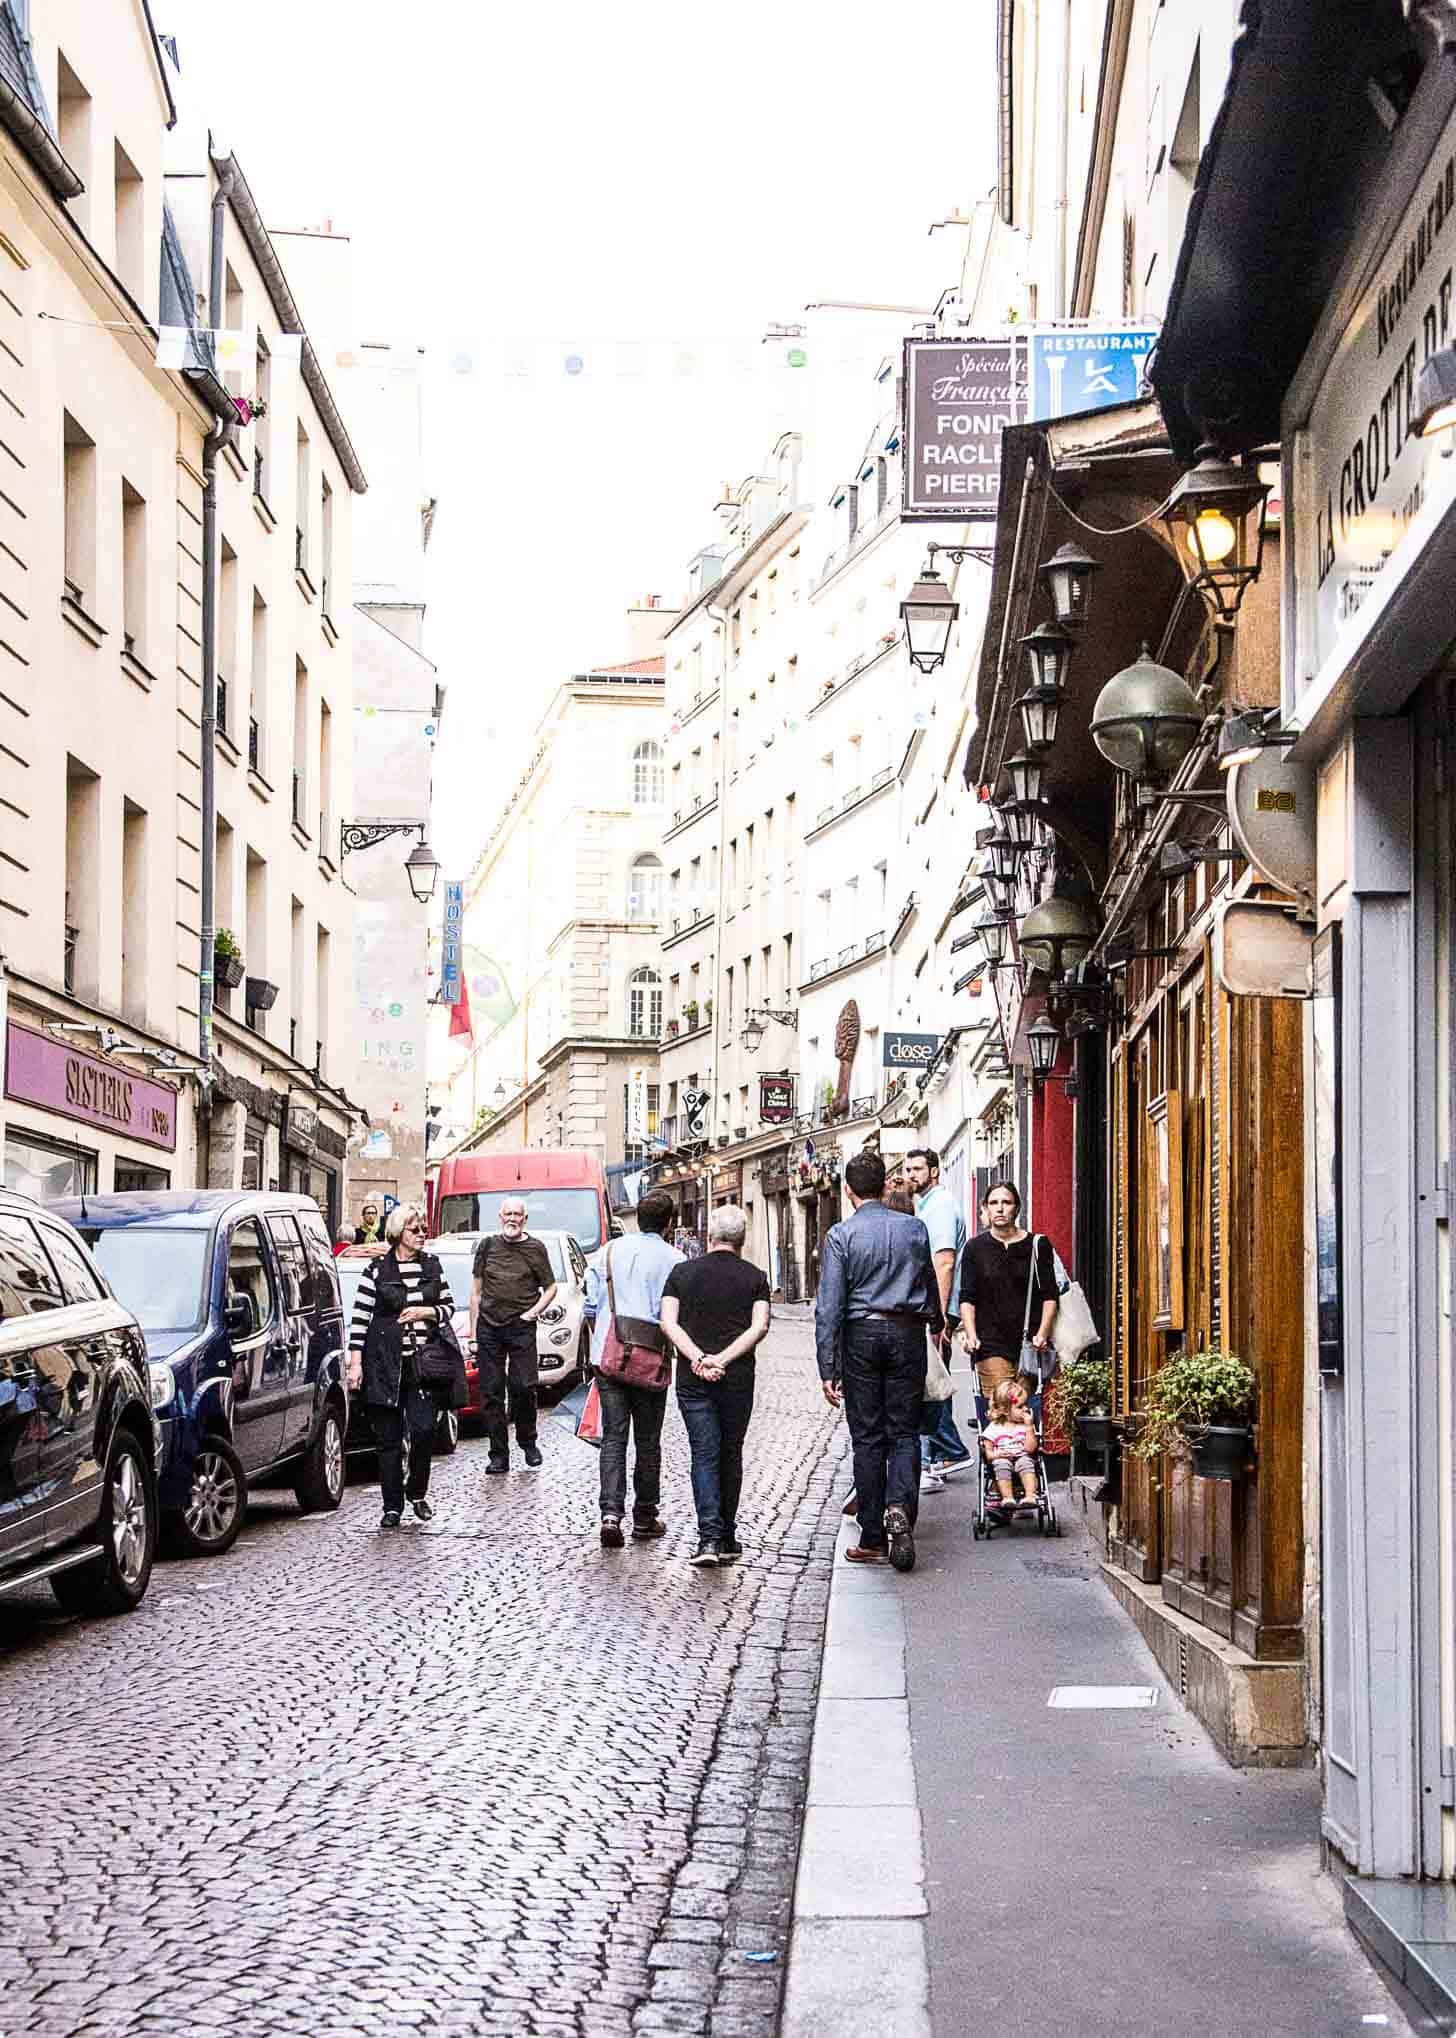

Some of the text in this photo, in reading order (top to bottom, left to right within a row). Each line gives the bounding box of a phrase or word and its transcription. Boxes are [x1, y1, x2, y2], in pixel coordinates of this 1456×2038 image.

[1043, 335, 1156, 352] RESTAURANT
[1317, 489, 1336, 591] LA
[1340, 338, 1416, 545] GROTTE
[444, 886, 463, 1002] HOSTEL
[65, 1057, 133, 1123] SISTERS
